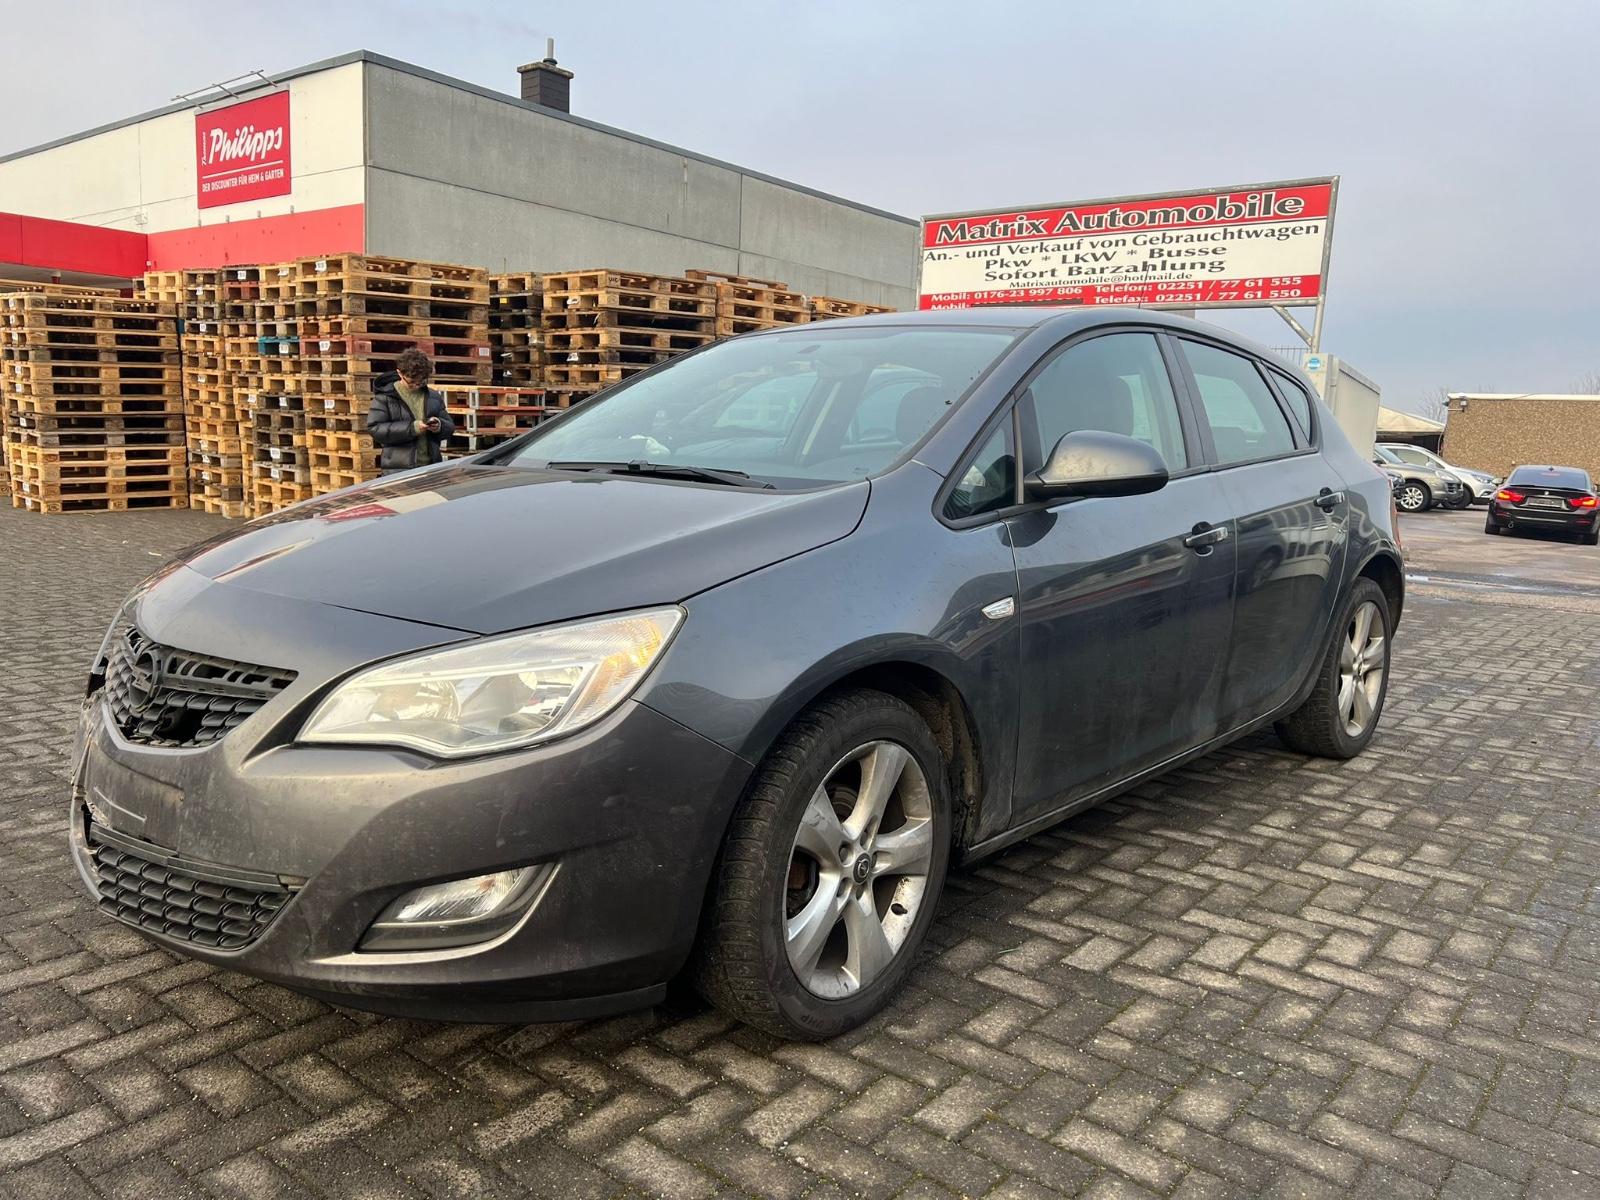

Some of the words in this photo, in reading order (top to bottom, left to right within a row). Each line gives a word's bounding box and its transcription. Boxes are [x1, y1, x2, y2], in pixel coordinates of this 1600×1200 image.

[208, 124, 283, 165] Philipps
[202, 183, 211, 192] DER
[211, 177, 238, 191] DISCOUNTER
[238, 174, 248, 186] FÜR
[248, 173, 260, 184] HEIM
[265, 168, 284, 181] GARTEN
[935, 215, 1050, 244] Matrix
[1053, 191, 1304, 235] Automobile
[924, 250, 960, 262] An.-
[966, 245, 1001, 259] und
[1007, 239, 1084, 256] Verkauf
[1089, 238, 1127, 248] von
[1132, 224, 1319, 246] Gebrauchtwagen
[985, 258, 1032, 270] Pkw
[1061, 251, 1117, 265] LKW
[1148, 245, 1227, 259] Busse
[984, 267, 1059, 282] Sofort
[1067, 260, 1226, 277] Barzahlung
[1009, 272, 1193, 288] Matrixautomobile@hotmail.de
[931, 290, 970, 302] Mobil:
[974, 288, 1025, 299] 0176-23
[1029, 287, 1053, 296] 997
[1056, 286, 1083, 295] 806
[1095, 283, 1152, 293] Telefon:
[1157, 281, 1204, 292] 02251
[1220, 279, 1240, 289] 77
[1244, 278, 1263, 287] 61
[1270, 276, 1302, 286] 555
[1095, 294, 1149, 305] Telefax:
[1155, 292, 1201, 303] 02251
[1218, 291, 1238, 300] 77
[1243, 289, 1262, 299] 61
[1269, 288, 1301, 298] 550
